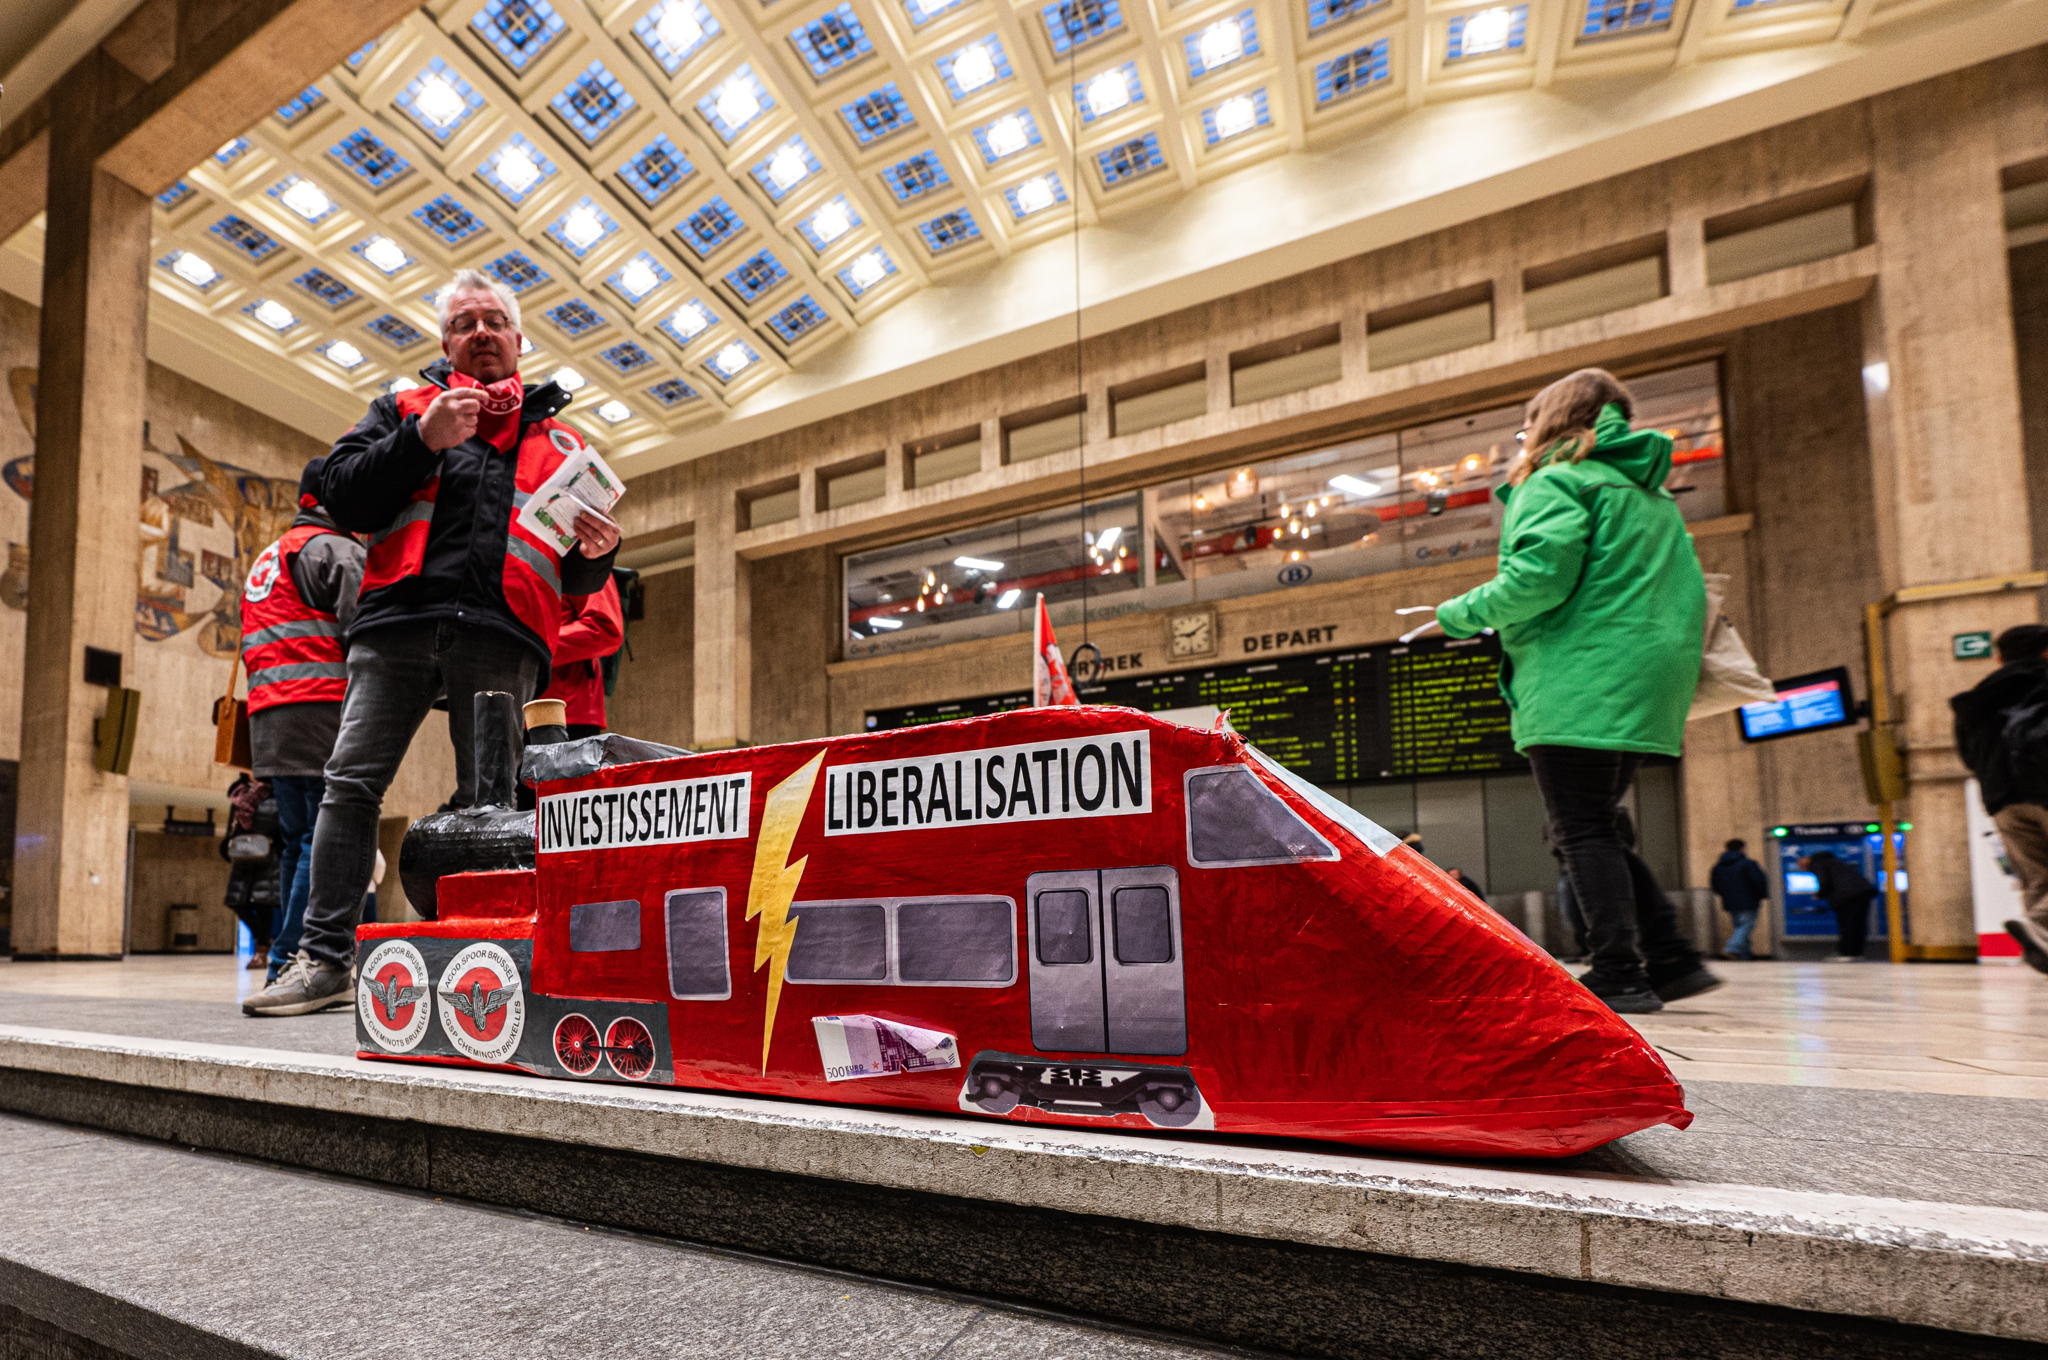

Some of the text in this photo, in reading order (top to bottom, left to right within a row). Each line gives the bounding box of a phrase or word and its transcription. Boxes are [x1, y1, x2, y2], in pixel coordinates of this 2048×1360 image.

[1243, 625, 1338, 653] DEPART
[828, 739, 1143, 830] LIBERALISATION
[541, 778, 746, 849] INVESTISSEMENT
[368, 946, 425, 985] ACOD SPOOR BRUSSEL
[445, 949, 515, 988] ACOD SPOOR BRUSSEL
[361, 994, 428, 1048] CGSP CHEMINOTS BRUXELLES
[443, 1000, 521, 1060] CGSP CHEMINOTS BRUXELLES
[827, 1066, 846, 1079] 500
[845, 1064, 864, 1072] EURO
